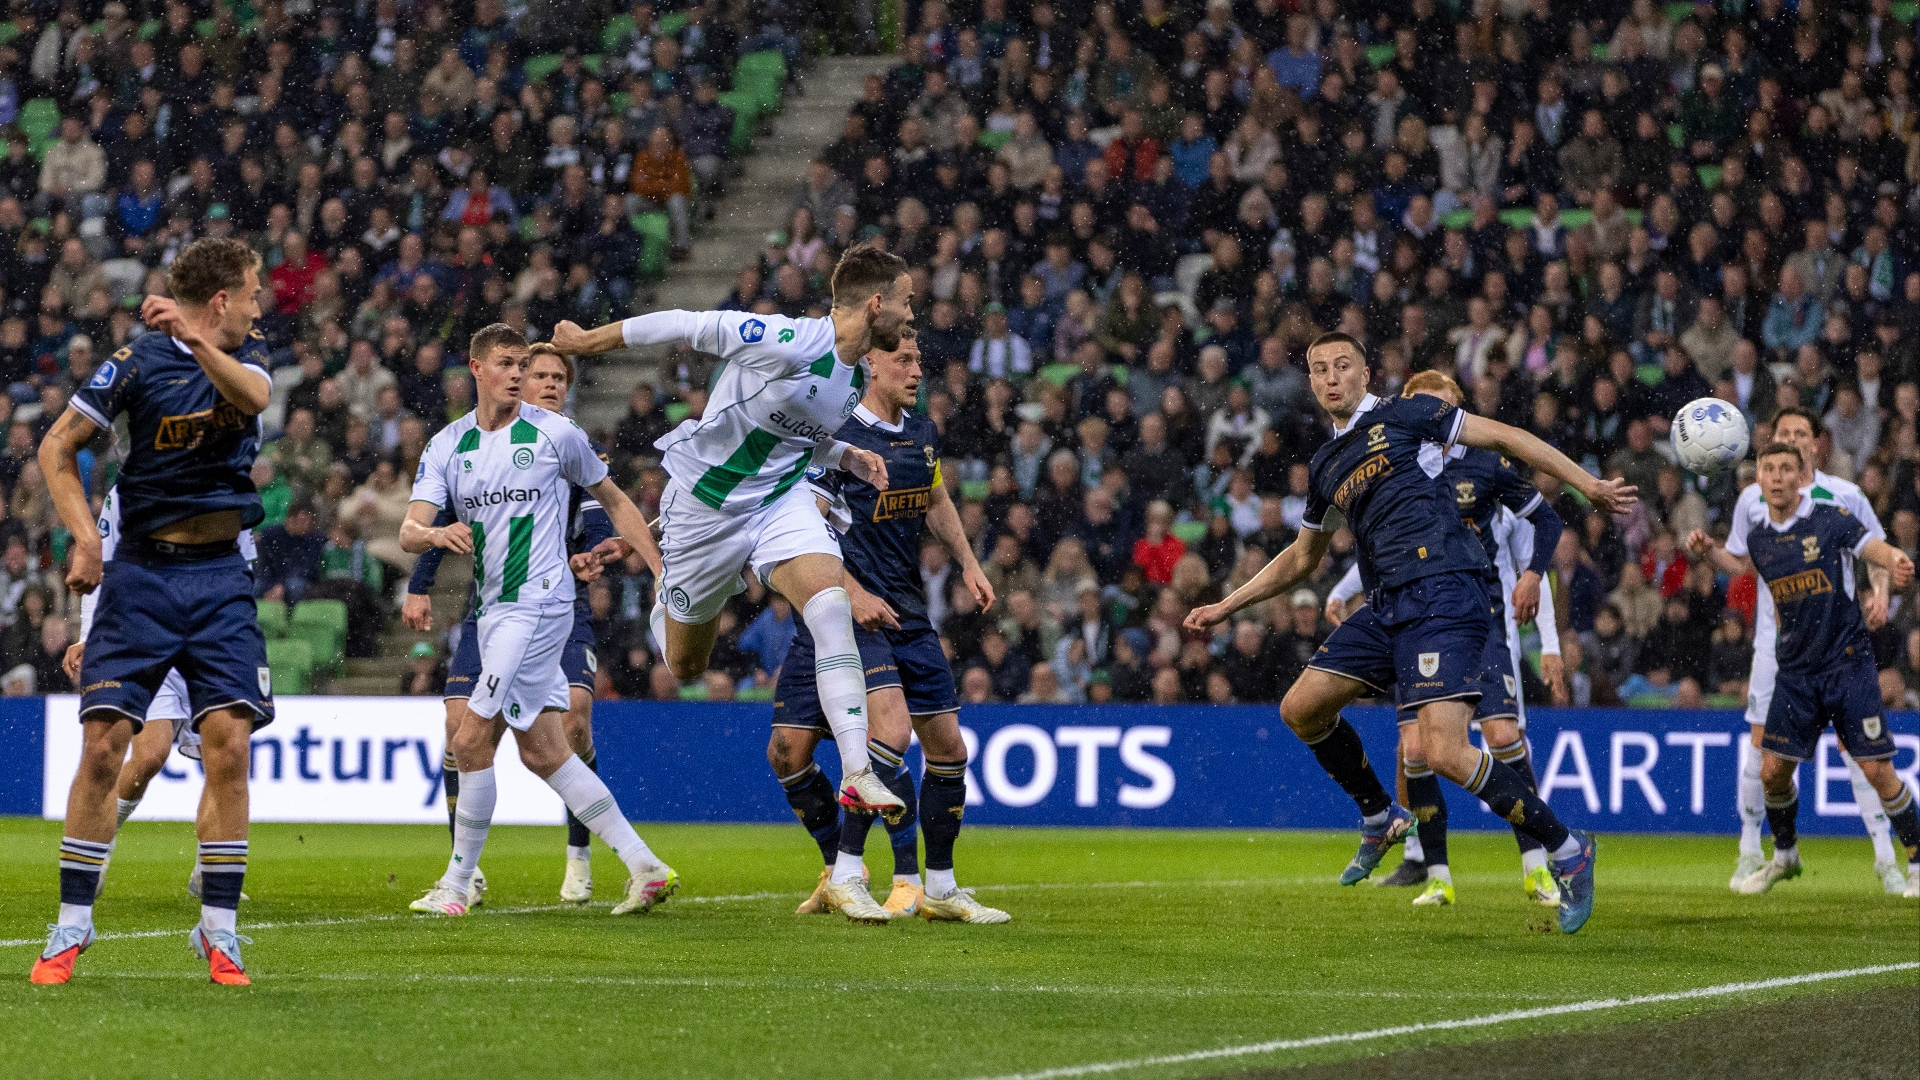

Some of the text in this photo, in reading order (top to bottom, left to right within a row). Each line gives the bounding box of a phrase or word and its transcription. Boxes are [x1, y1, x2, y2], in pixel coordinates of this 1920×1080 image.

[769, 410, 832, 443] autoka
[463, 485, 541, 510] autokan
[888, 491, 929, 511] RETRO
[486, 673, 501, 698] 4
[160, 725, 446, 808] ntury
[905, 723, 1177, 810] ROTS
[1478, 729, 1920, 816] ARTER
